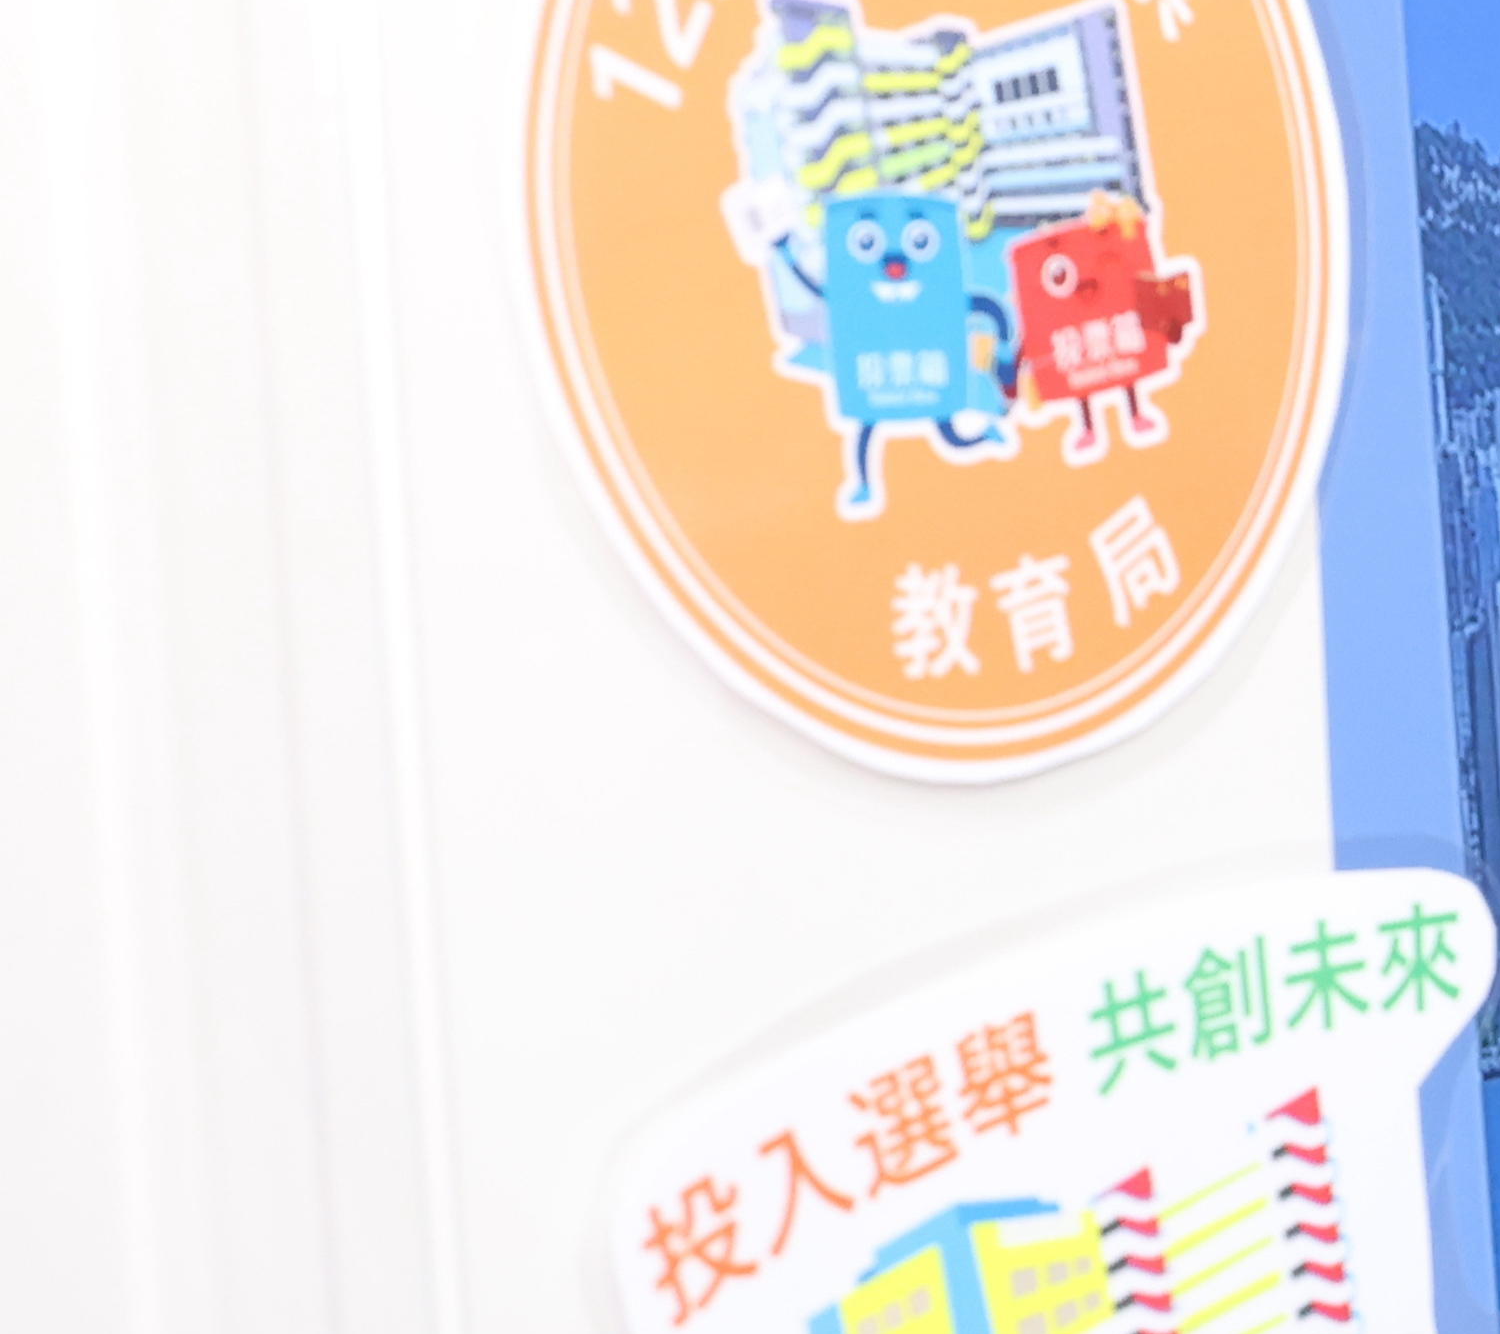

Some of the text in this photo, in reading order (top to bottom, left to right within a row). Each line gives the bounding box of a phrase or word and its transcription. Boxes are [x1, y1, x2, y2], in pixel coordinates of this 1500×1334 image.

[891, 495, 1183, 679] 教育局
[637, 901, 1463, 1329] 投入選舉 共創未來
